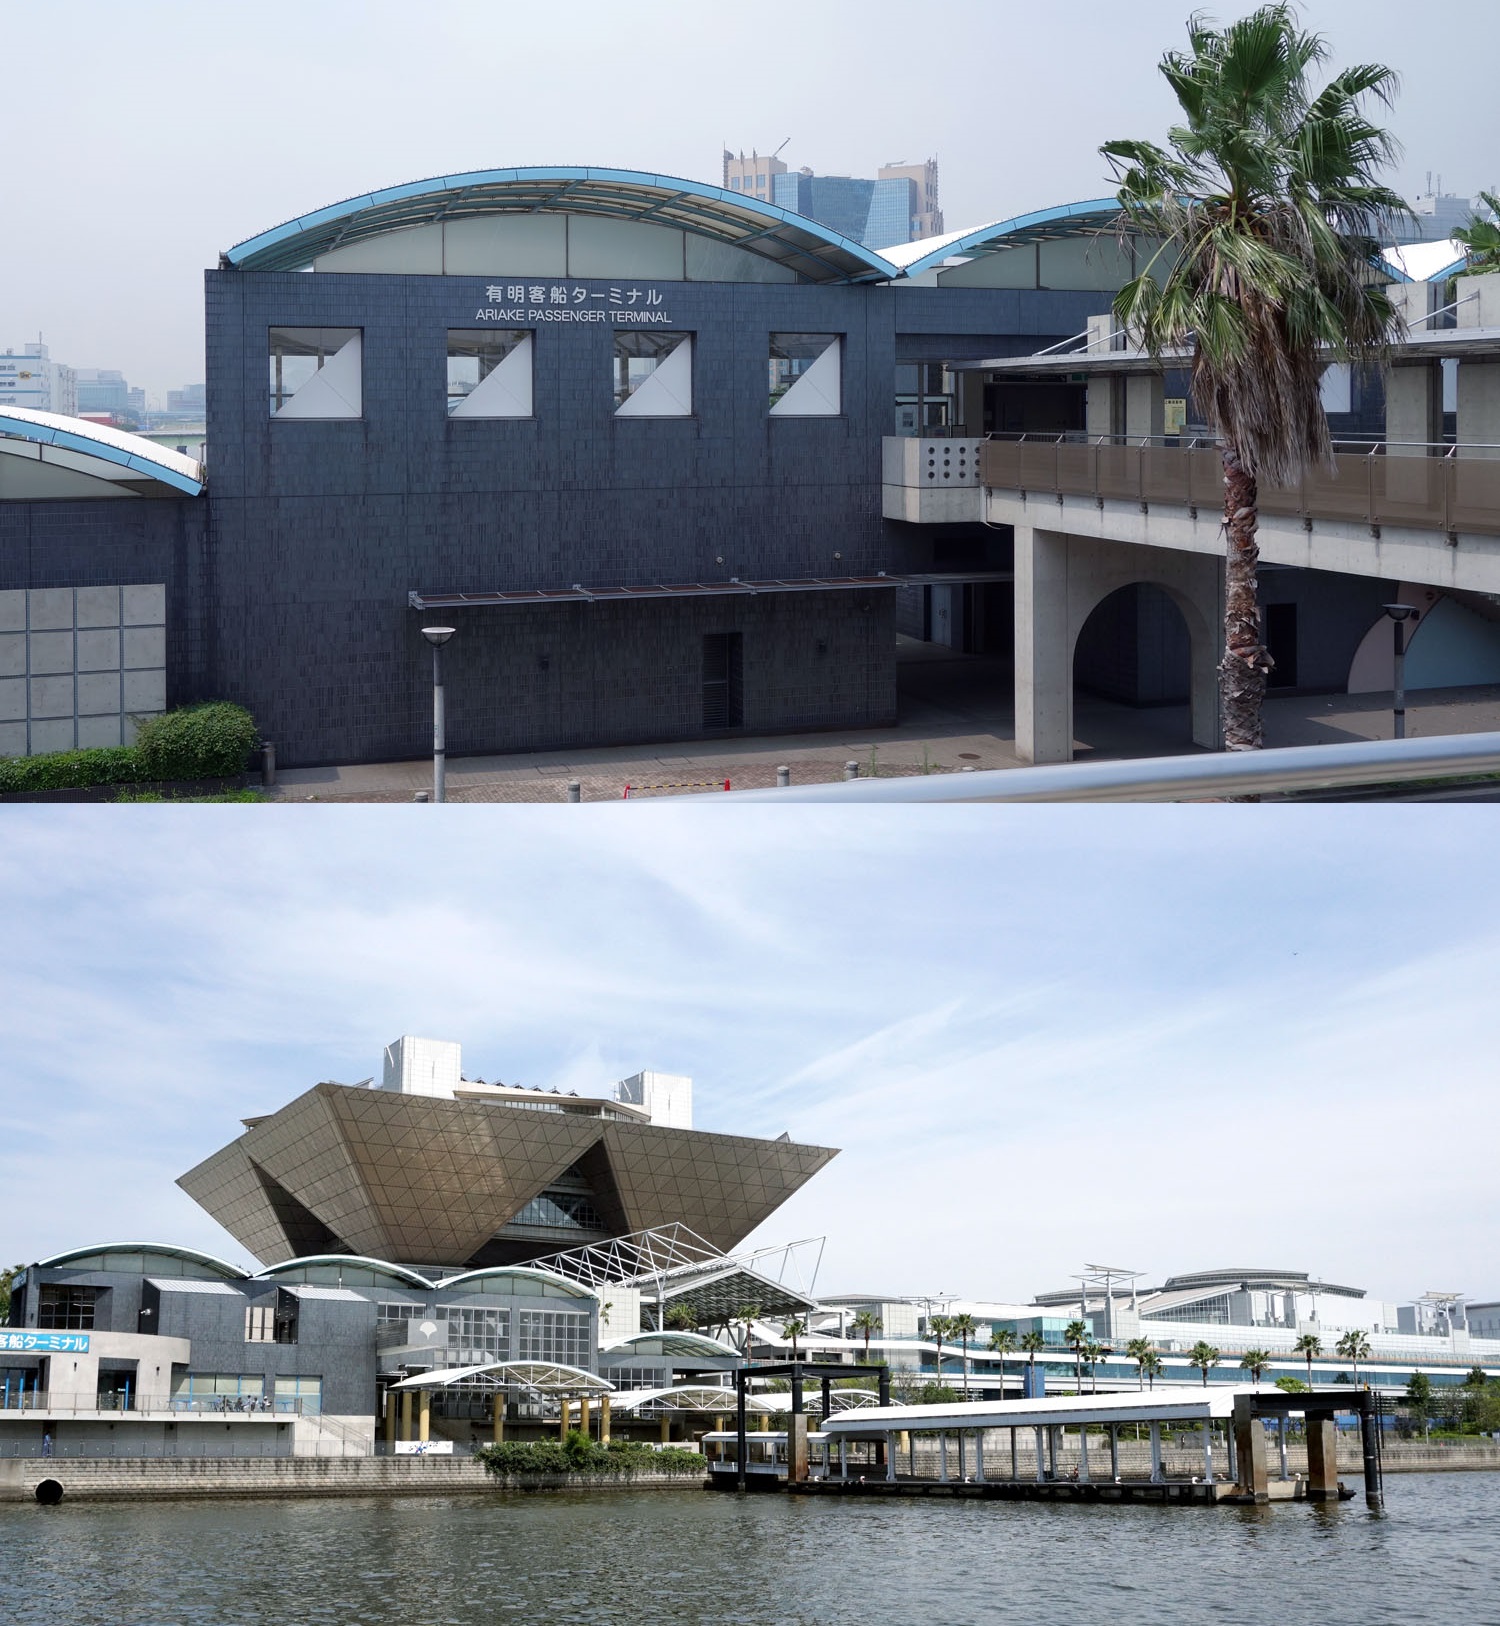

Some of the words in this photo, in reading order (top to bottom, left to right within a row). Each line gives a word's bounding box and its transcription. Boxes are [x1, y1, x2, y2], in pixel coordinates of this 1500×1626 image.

[486, 285, 663, 305] 有明客船ターミナル
[475, 309, 525, 321] ARIAKE
[528, 310, 606, 322] PASSENGER
[609, 311, 672, 323] TERMINAL
